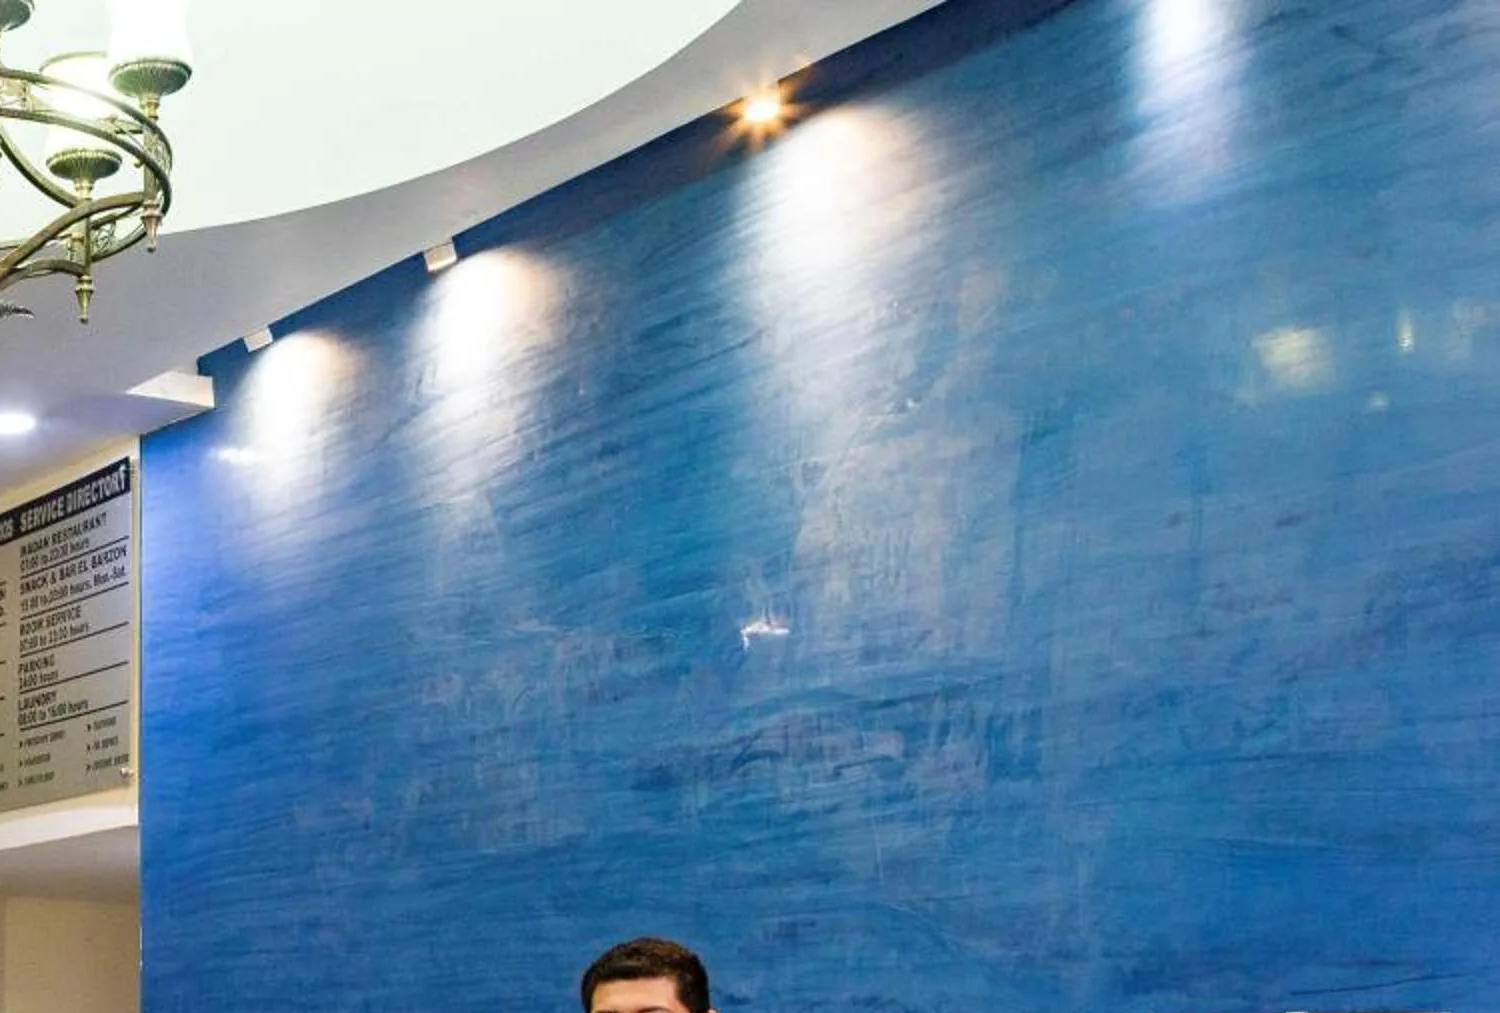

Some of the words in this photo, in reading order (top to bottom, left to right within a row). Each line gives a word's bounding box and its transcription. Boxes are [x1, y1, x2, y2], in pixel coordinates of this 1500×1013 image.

[20, 495, 64, 532] SERVICE
[66, 466, 124, 513] DIRECTORY
[51, 511, 106, 546] RESTAURANT
[20, 573, 48, 596] SNACK
[59, 562, 75, 581] BAR
[77, 557, 88, 574] EL
[20, 616, 44, 637] ROOM
[45, 603, 81, 629] SERVICE
[18, 652, 54, 676] PARKING
[18, 689, 56, 712] LAUNDRY
